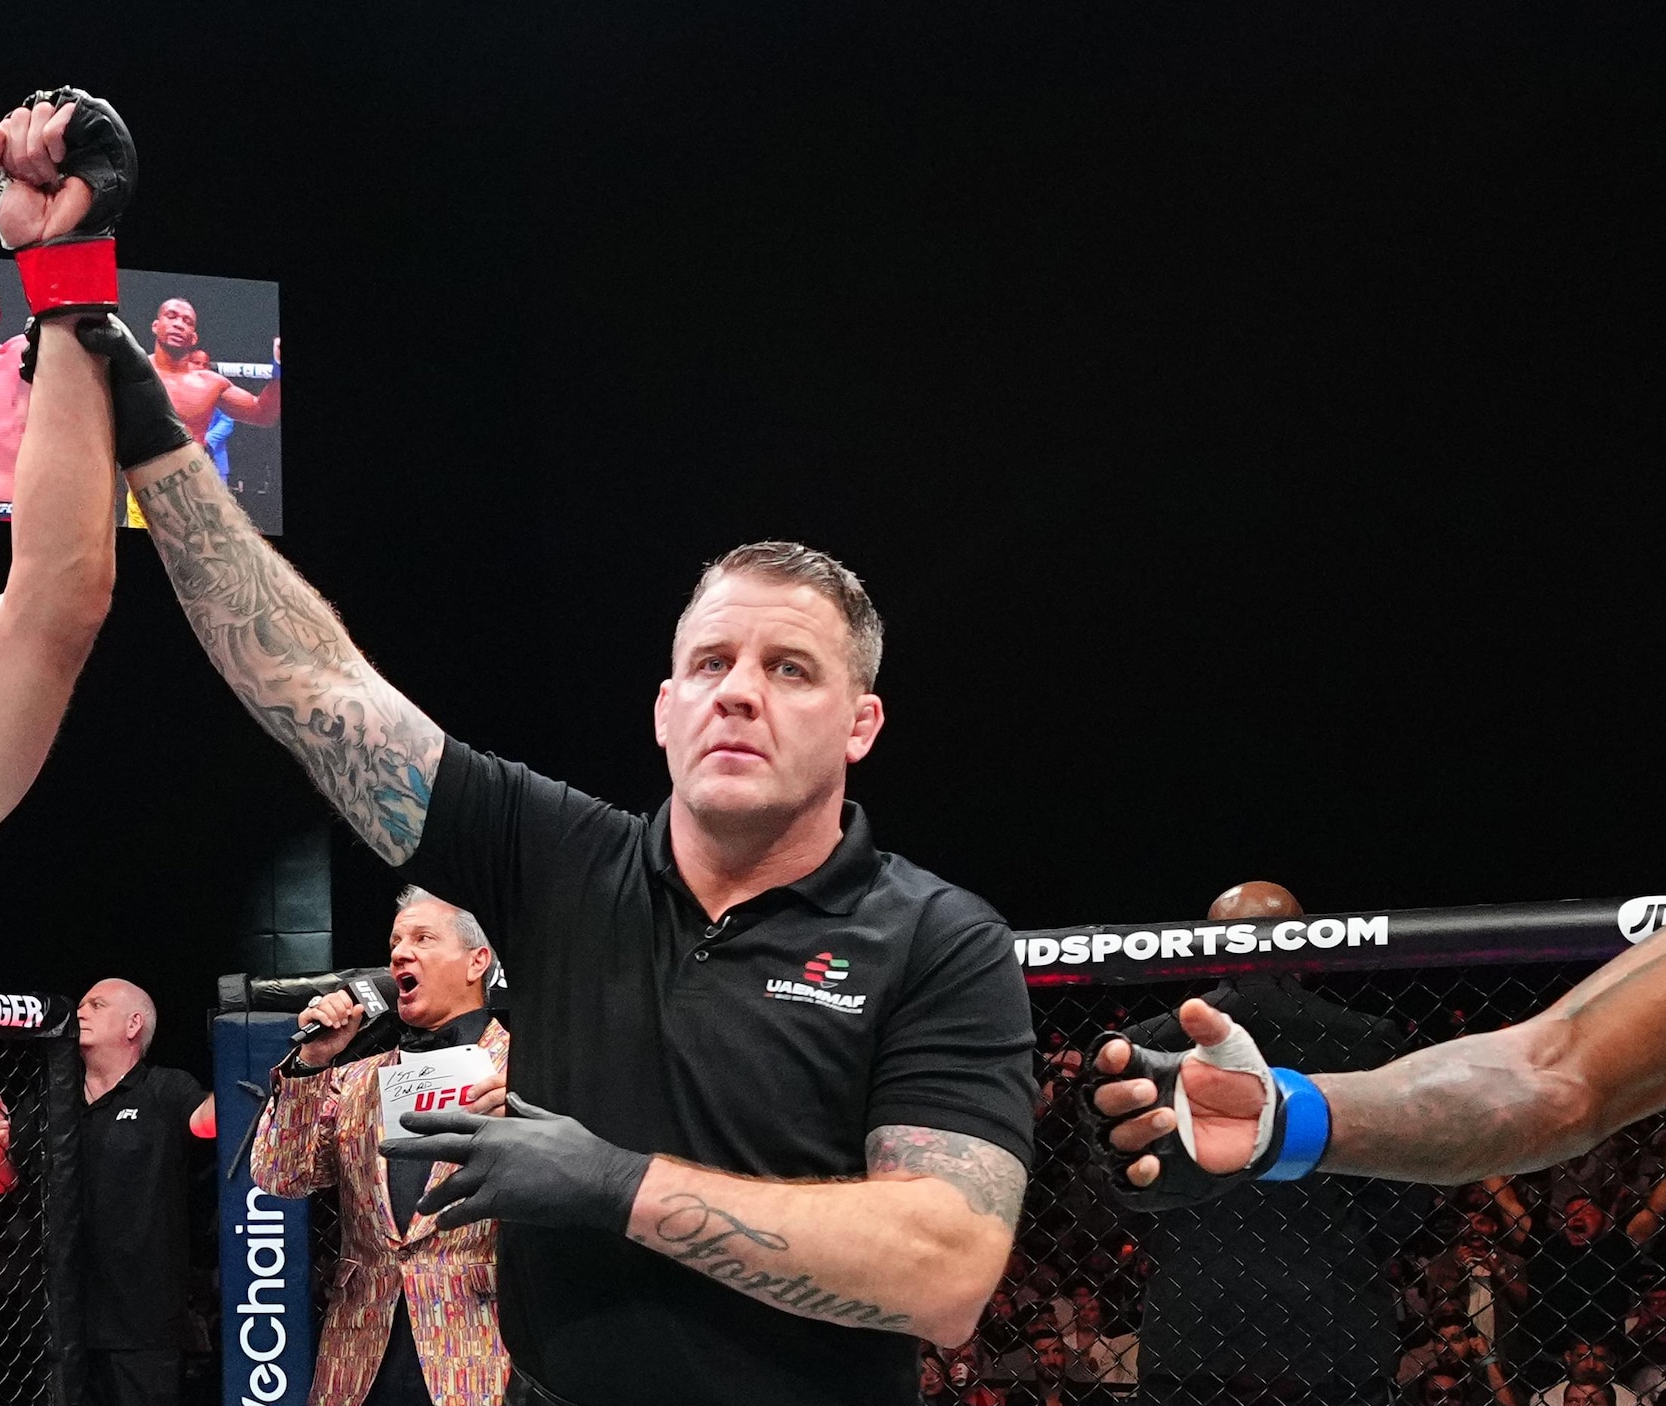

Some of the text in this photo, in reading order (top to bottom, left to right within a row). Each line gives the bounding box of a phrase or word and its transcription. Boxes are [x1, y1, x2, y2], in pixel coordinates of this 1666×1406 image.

[355, 980, 384, 1013] UFC
[766, 979, 867, 1009] UAEMMAF
[414, 1084, 474, 1112] UFC
